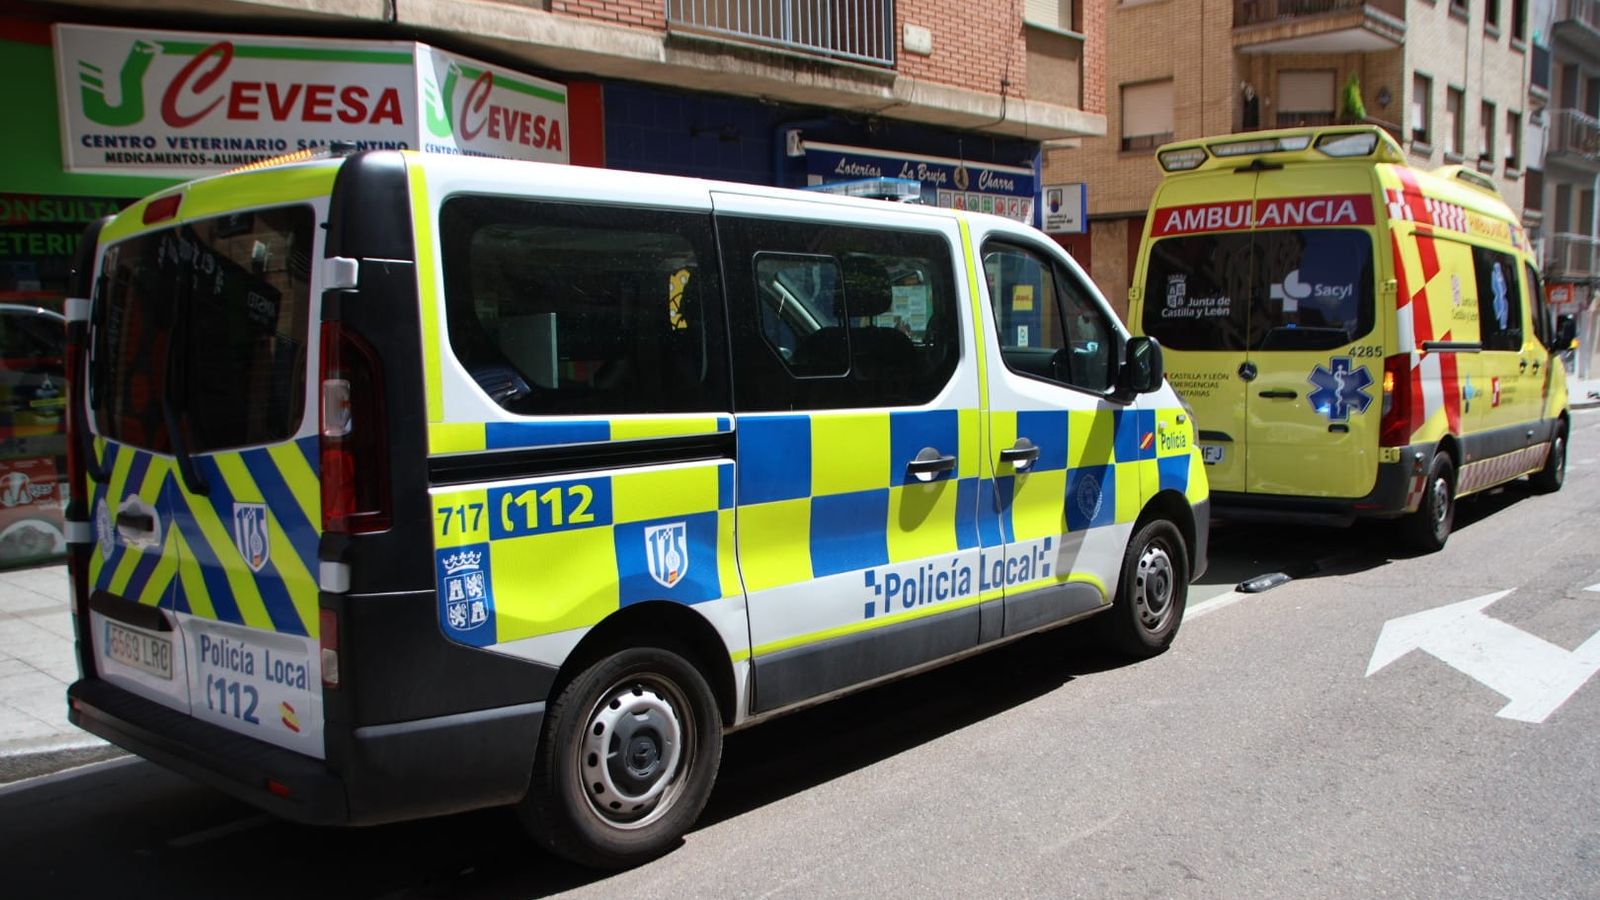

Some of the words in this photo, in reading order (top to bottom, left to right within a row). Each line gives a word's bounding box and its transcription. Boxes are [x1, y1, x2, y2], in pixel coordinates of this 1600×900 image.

[161, 41, 403, 128] CEVESA
[460, 71, 562, 151] CEVESA
[82, 134, 156, 148] CENTRO
[166, 137, 287, 151] VETERINARIO
[899, 162, 914, 180] La
[917, 163, 948, 184] Bruja
[978, 168, 1015, 192] Charra
[1164, 200, 1357, 232] AMBULANCIA
[1188, 297, 1215, 307] Junta
[1217, 296, 1231, 306] de
[1314, 283, 1353, 300] Sacyl
[1161, 308, 1194, 318] Castilla
[1196, 308, 1203, 319] y
[1204, 306, 1230, 316] León
[1348, 346, 1383, 358] 4285
[1161, 430, 1187, 450] Policía
[438, 503, 484, 536] 717
[514, 484, 595, 529] 112
[885, 558, 971, 613] Policía
[979, 544, 1038, 592] Local
[200, 634, 254, 676] Policía
[214, 678, 260, 726] 112
